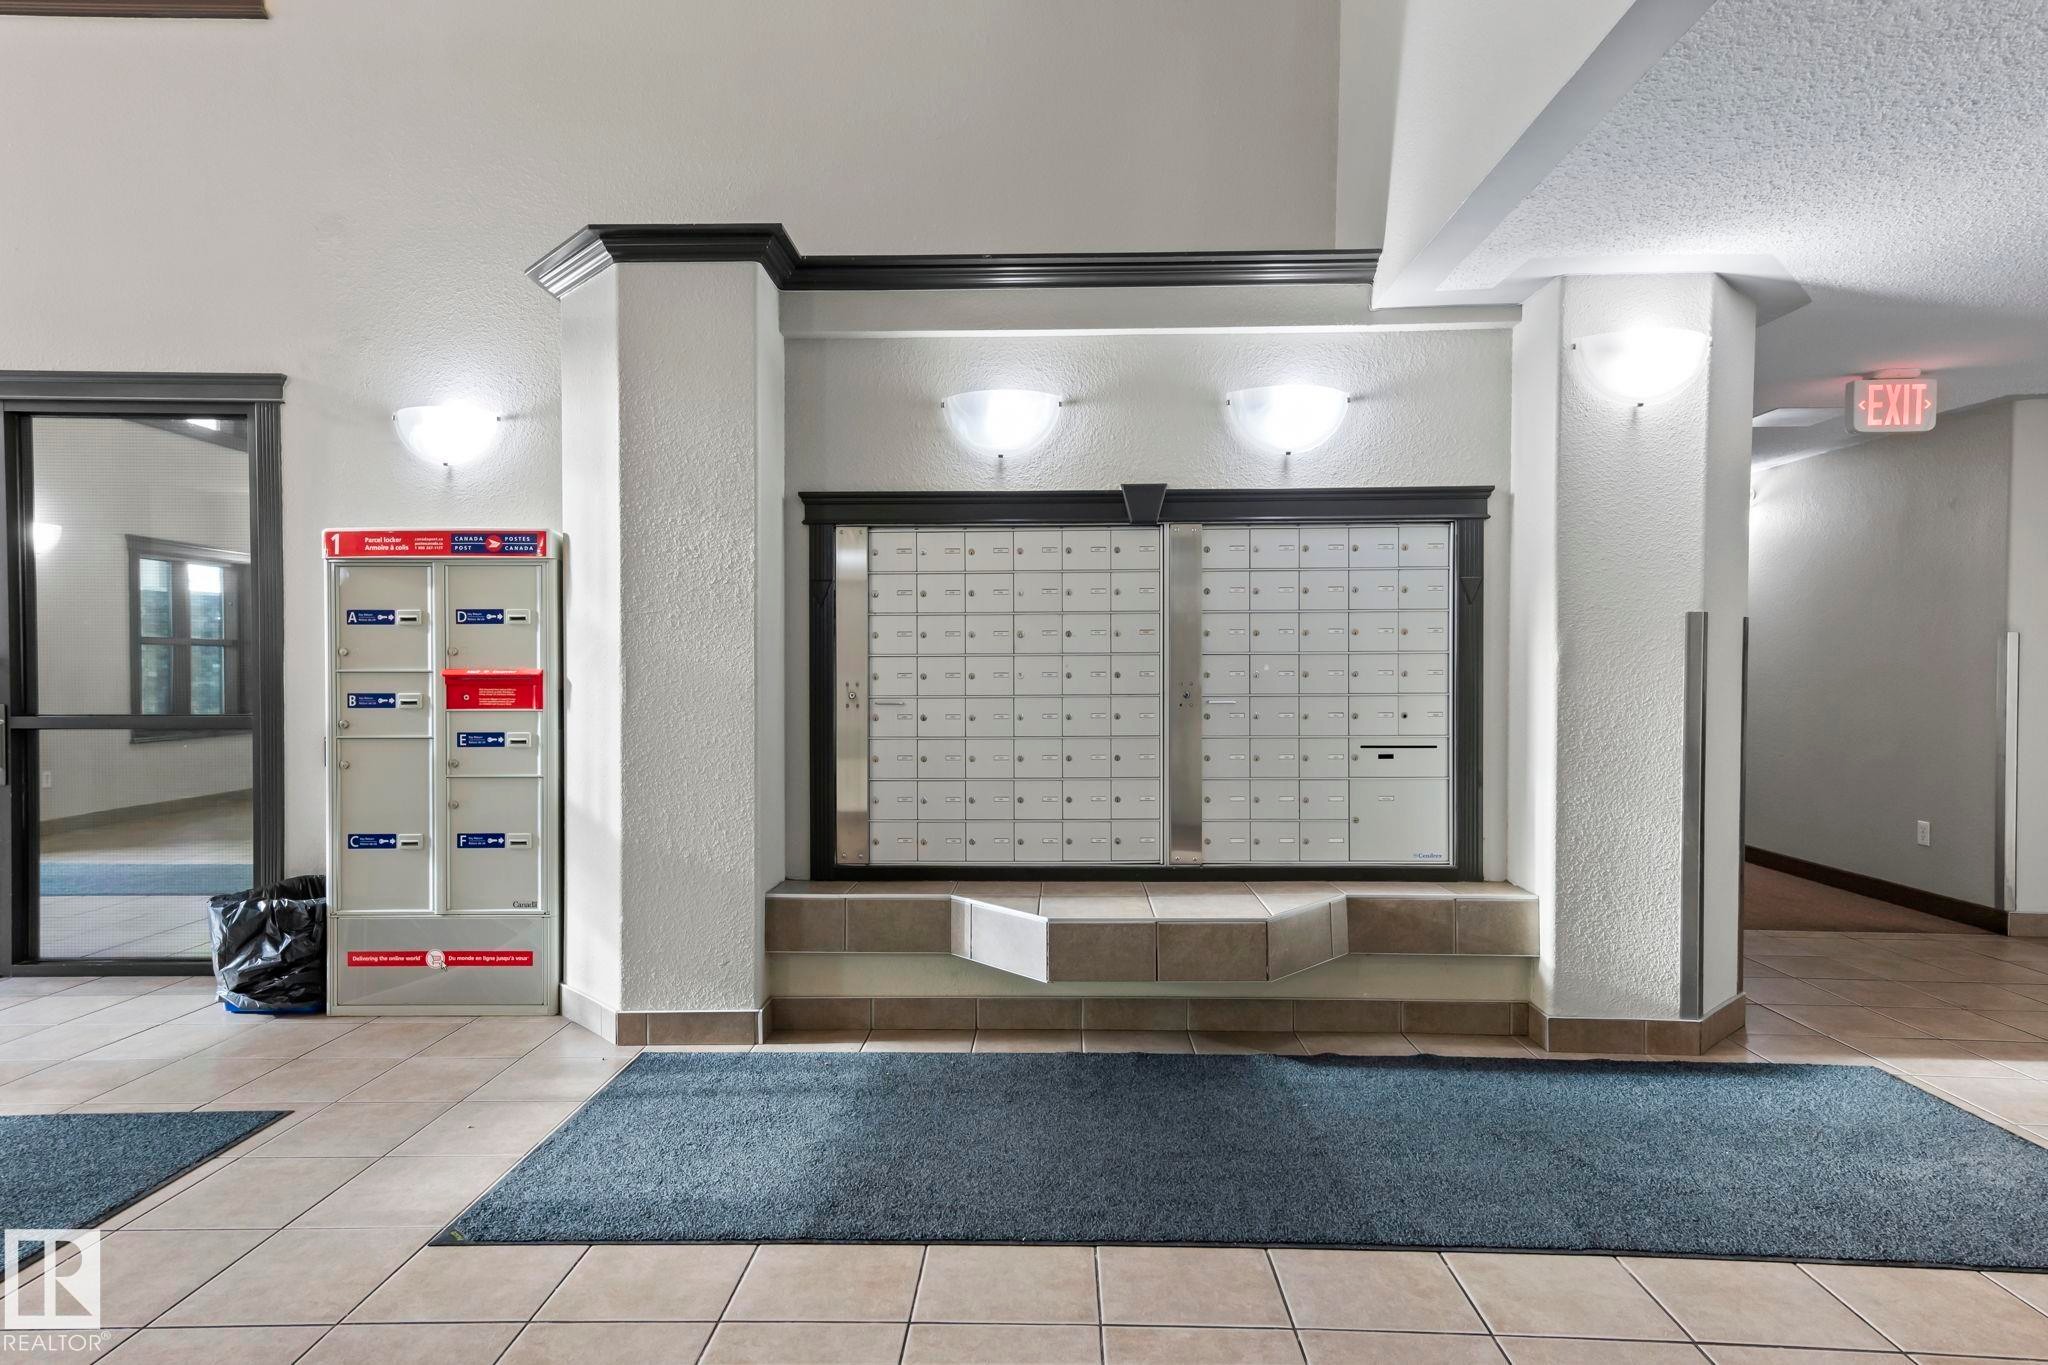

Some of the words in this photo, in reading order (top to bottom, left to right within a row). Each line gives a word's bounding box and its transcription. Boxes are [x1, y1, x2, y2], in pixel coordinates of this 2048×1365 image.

[1867, 384, 1927, 426] EXIT
[331, 533, 340, 555] 1
[347, 611, 358, 623] A
[457, 611, 467, 622] D
[349, 695, 356, 706] B
[459, 734, 467, 746] E
[350, 835, 359, 847] C
[460, 835, 467, 846] F
